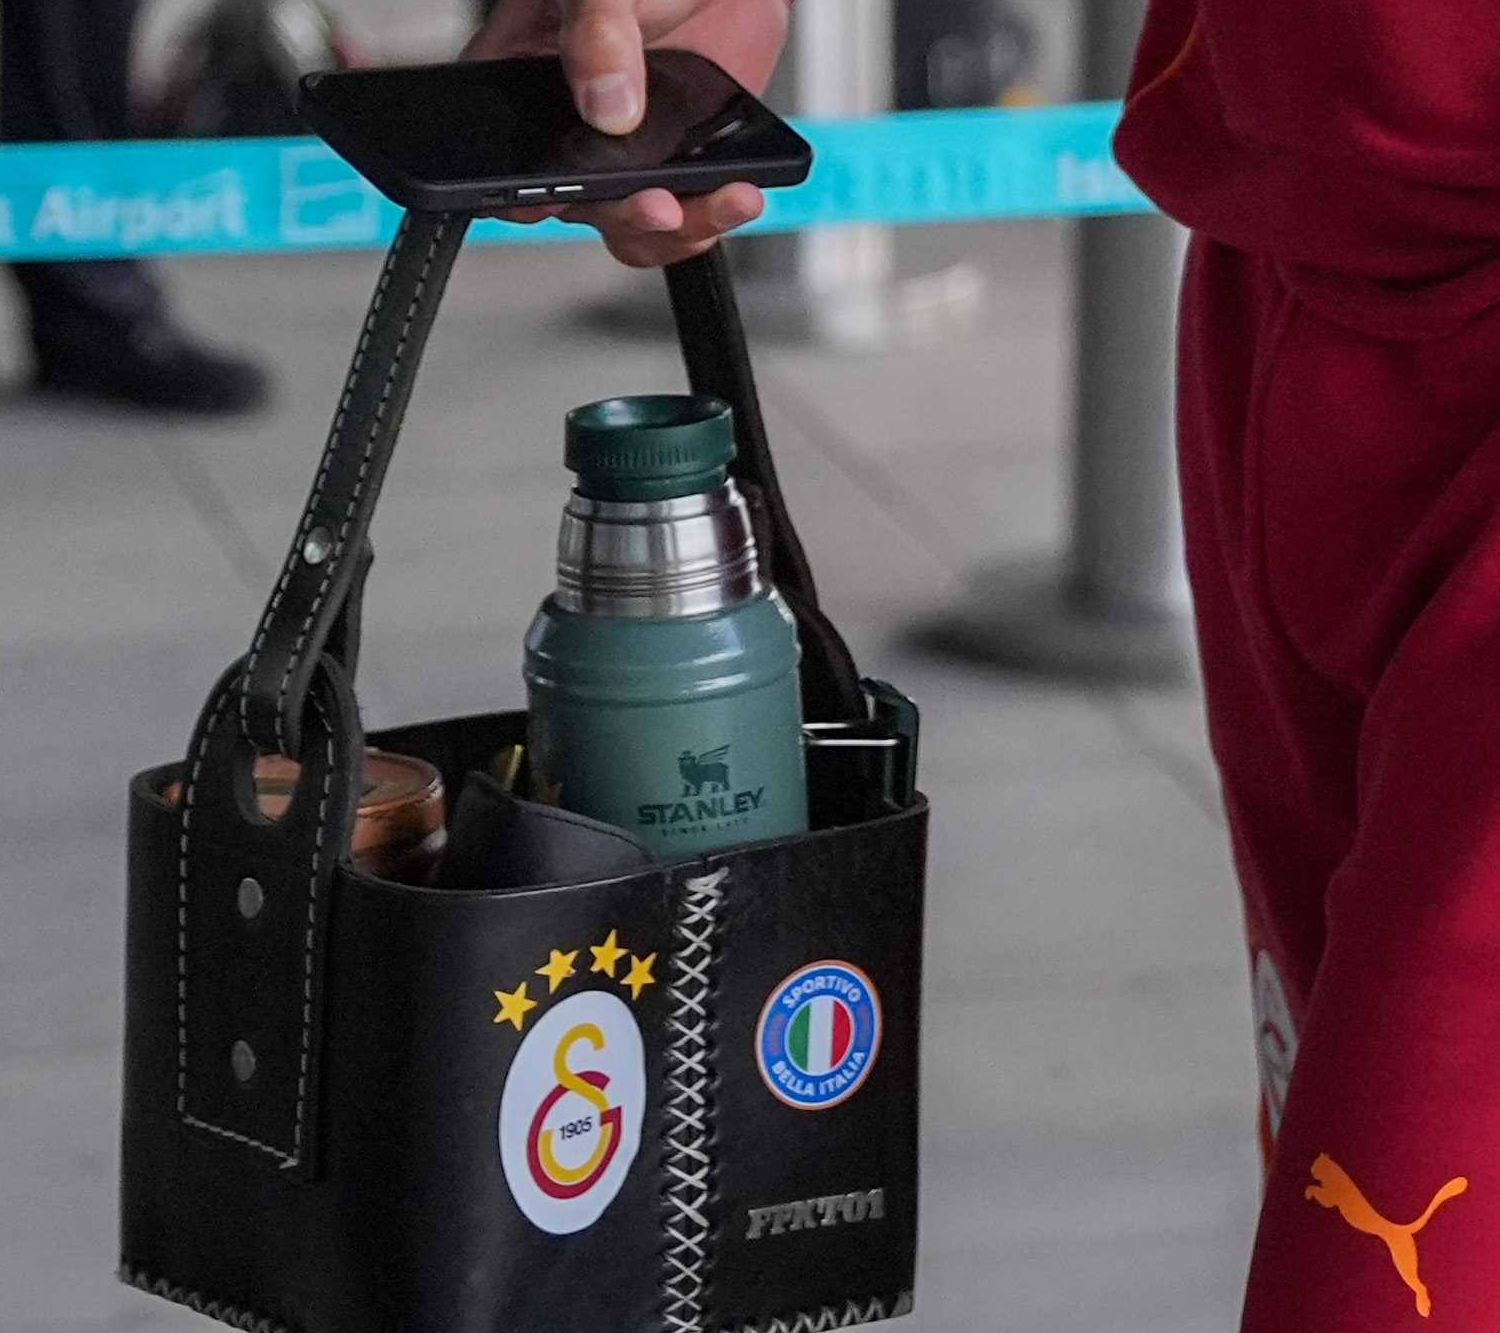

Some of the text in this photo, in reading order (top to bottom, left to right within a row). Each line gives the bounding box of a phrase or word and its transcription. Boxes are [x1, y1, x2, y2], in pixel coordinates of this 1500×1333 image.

[32, 169, 247, 247] Airport
[637, 785, 765, 826] STANLEY
[782, 975, 862, 1009] SPORTIVO
[771, 1052, 866, 1096] BELLA ITALIA
[558, 1116, 593, 1141] 1905
